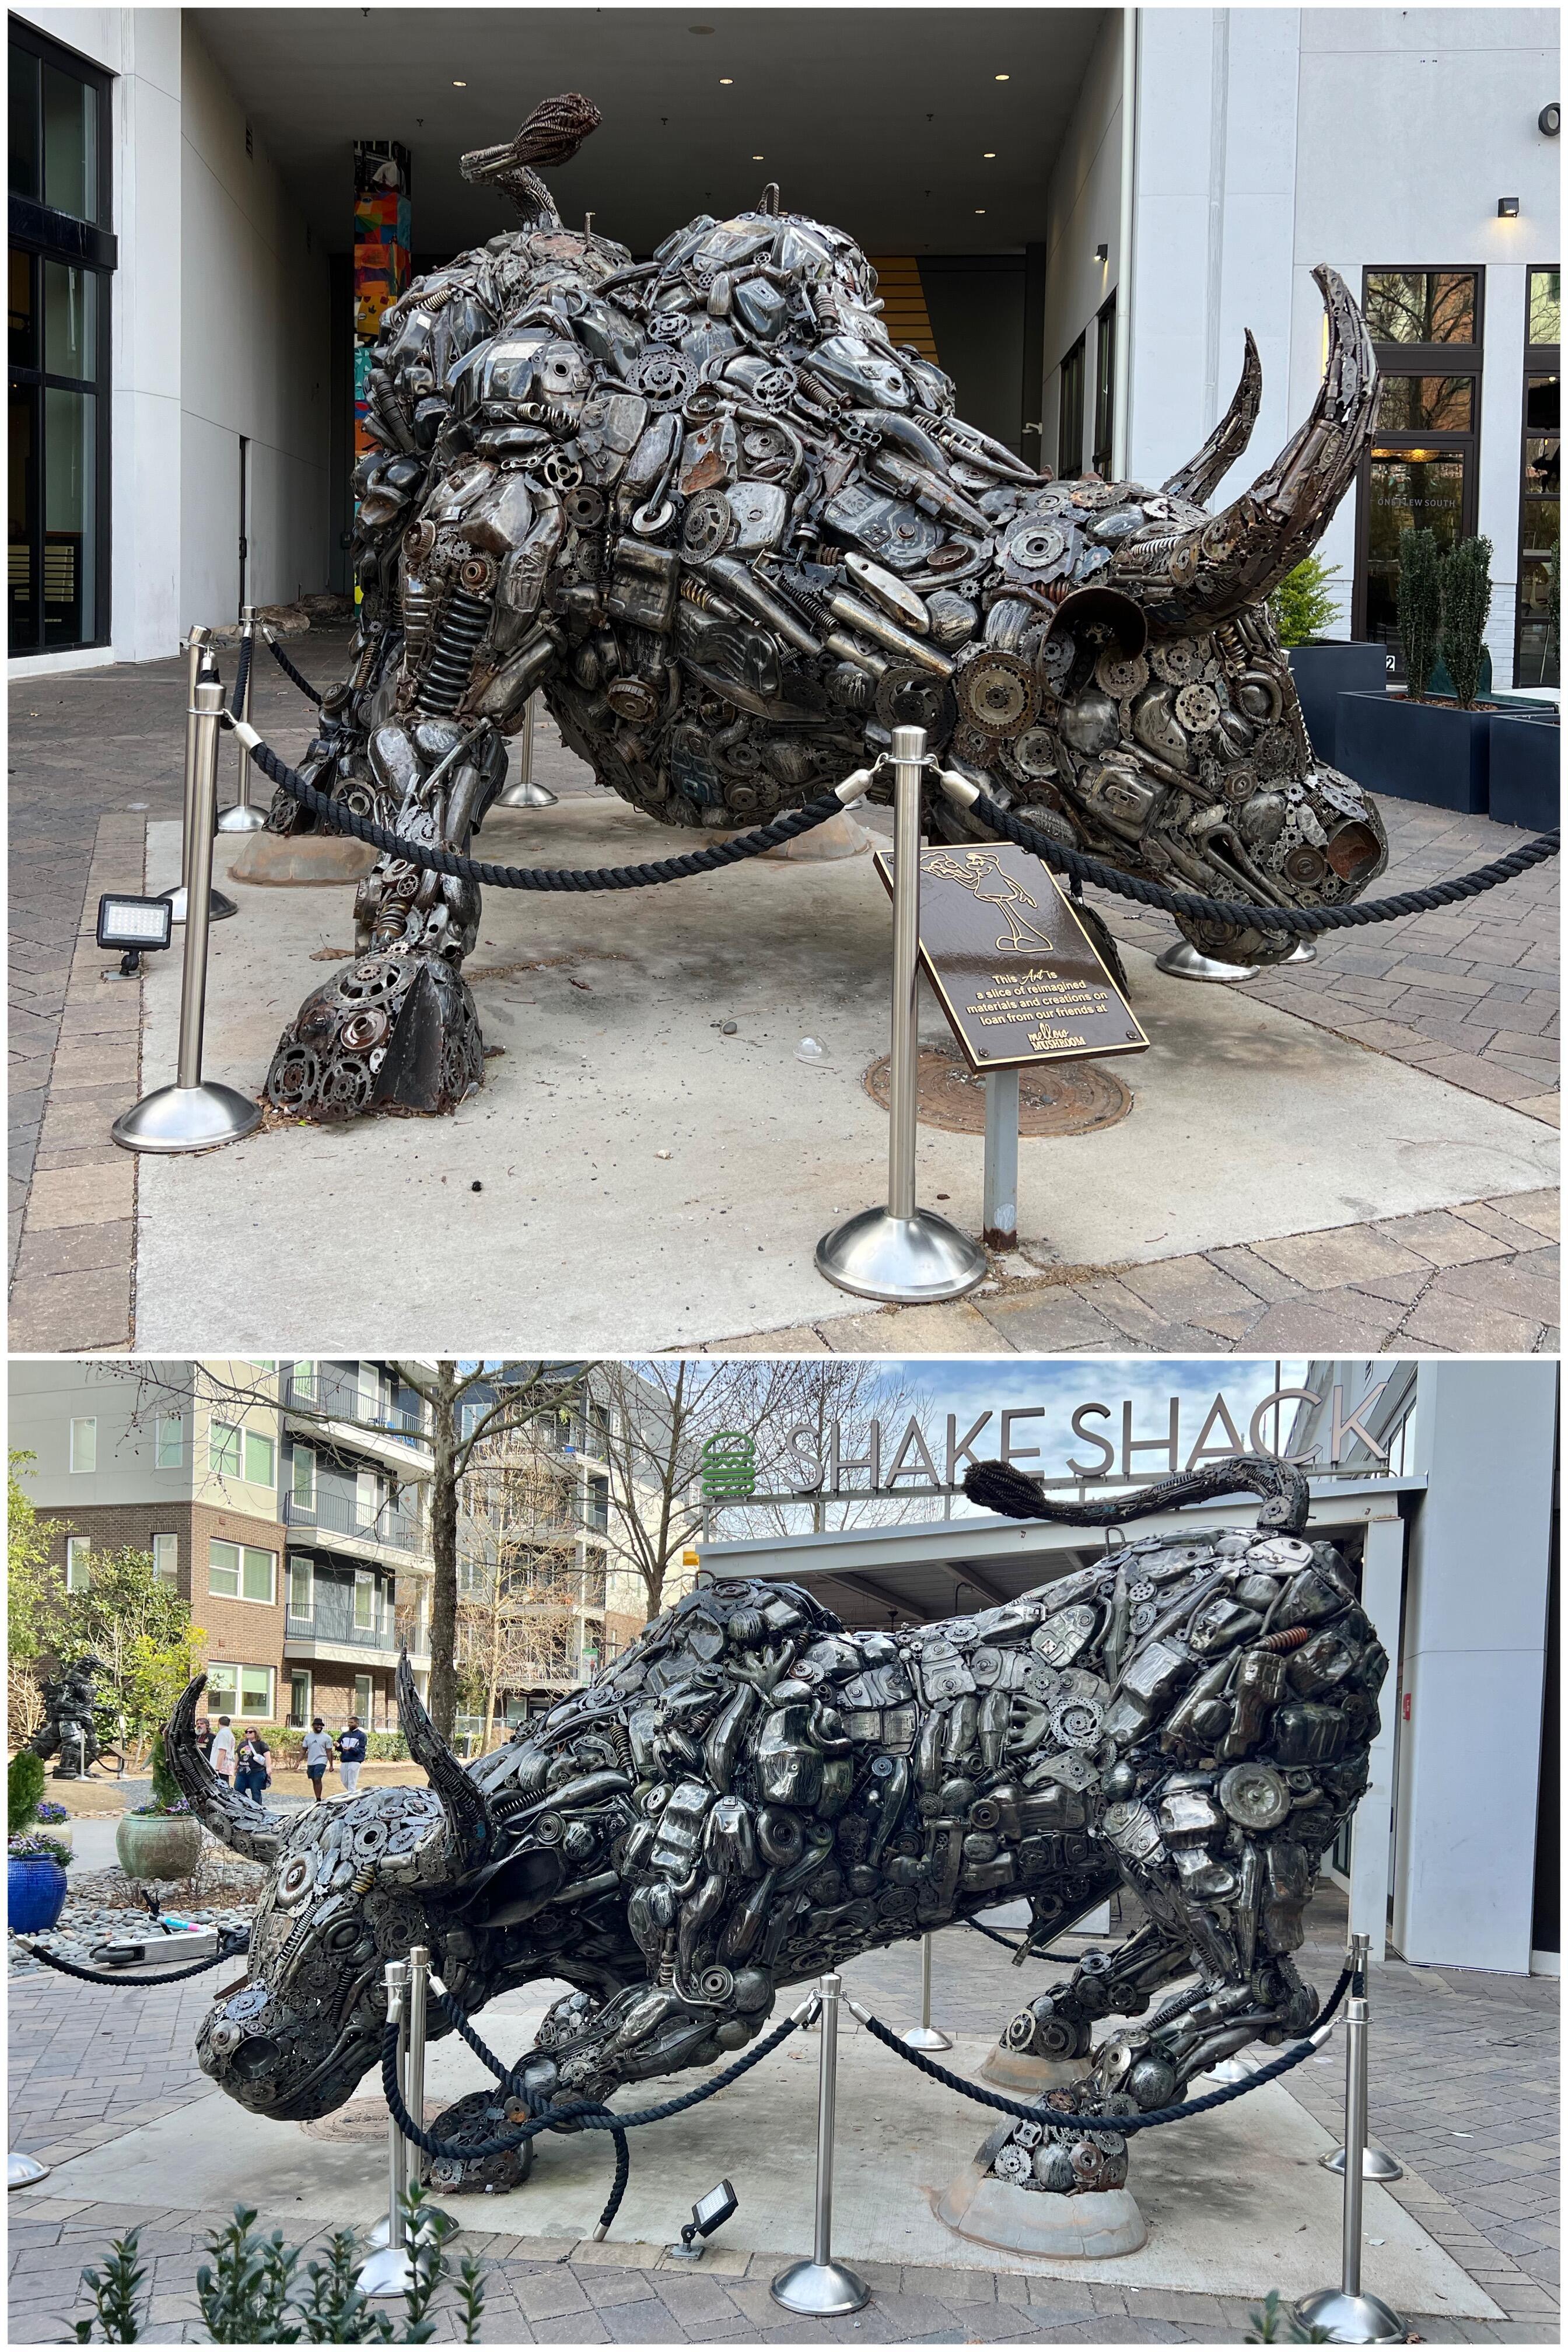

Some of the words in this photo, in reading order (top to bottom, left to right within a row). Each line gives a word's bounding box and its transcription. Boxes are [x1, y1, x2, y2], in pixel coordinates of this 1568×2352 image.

[1424, 499, 1455, 508] SOUTH
[992, 975, 1018, 985] This
[1020, 968, 1048, 985] Art
[1047, 971, 1058, 979] is
[976, 992, 984, 1000] a
[985, 988, 1012, 999] slice
[1014, 986, 1025, 996] of
[1027, 980, 1087, 994] reimagined
[966, 999, 1018, 1014] materials
[1019, 998, 1041, 1008] and
[1042, 992, 1091, 1006] creations
[1093, 992, 1108, 1000] on
[979, 1014, 1006, 1026] loan
[1007, 1012, 1034, 1023] from
[1035, 1010, 1055, 1020] our
[1055, 1004, 1095, 1019] friends
[1095, 1003, 1108, 1013] at
[1027, 1022, 1070, 1042] mellow
[1031, 1036, 1087, 1051] MUSHROOM
[782, 1407, 1045, 1493] SHAKE
[1066, 1382, 1388, 1477] SHACK
